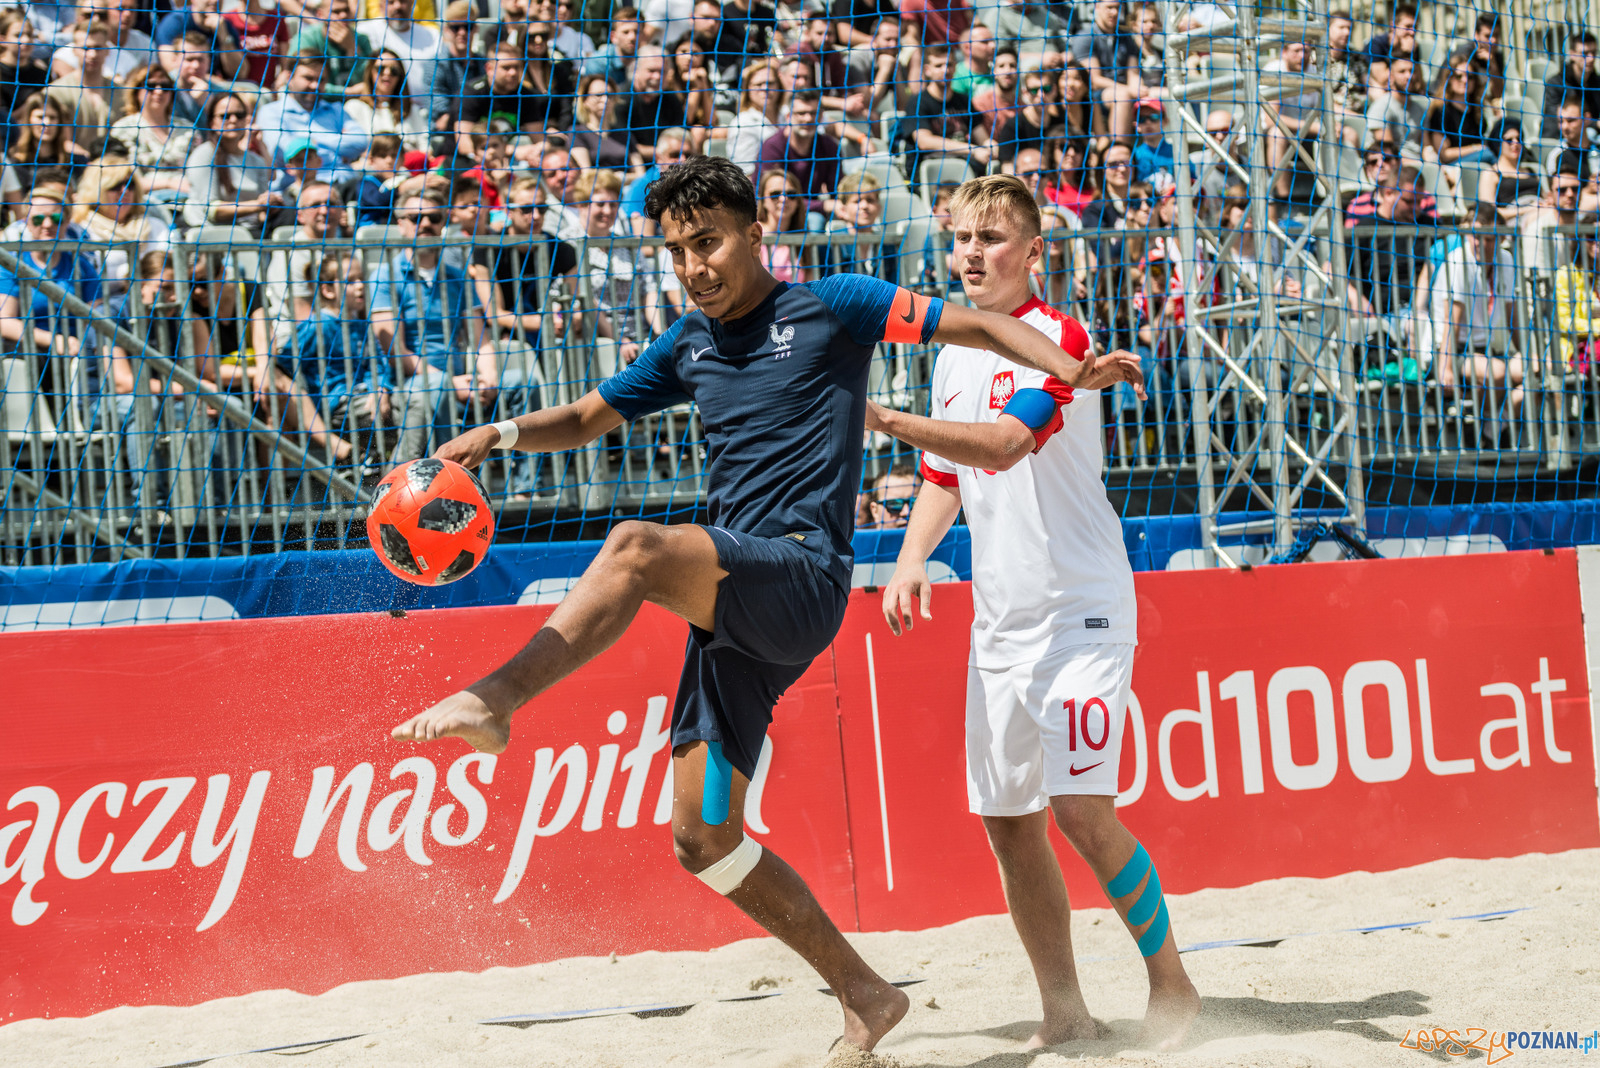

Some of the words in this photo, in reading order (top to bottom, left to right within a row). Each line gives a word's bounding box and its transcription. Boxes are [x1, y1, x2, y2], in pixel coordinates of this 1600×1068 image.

[775, 351, 791, 360] FFF
[1063, 696, 1110, 752] 10
[293, 753, 498, 872] nas
